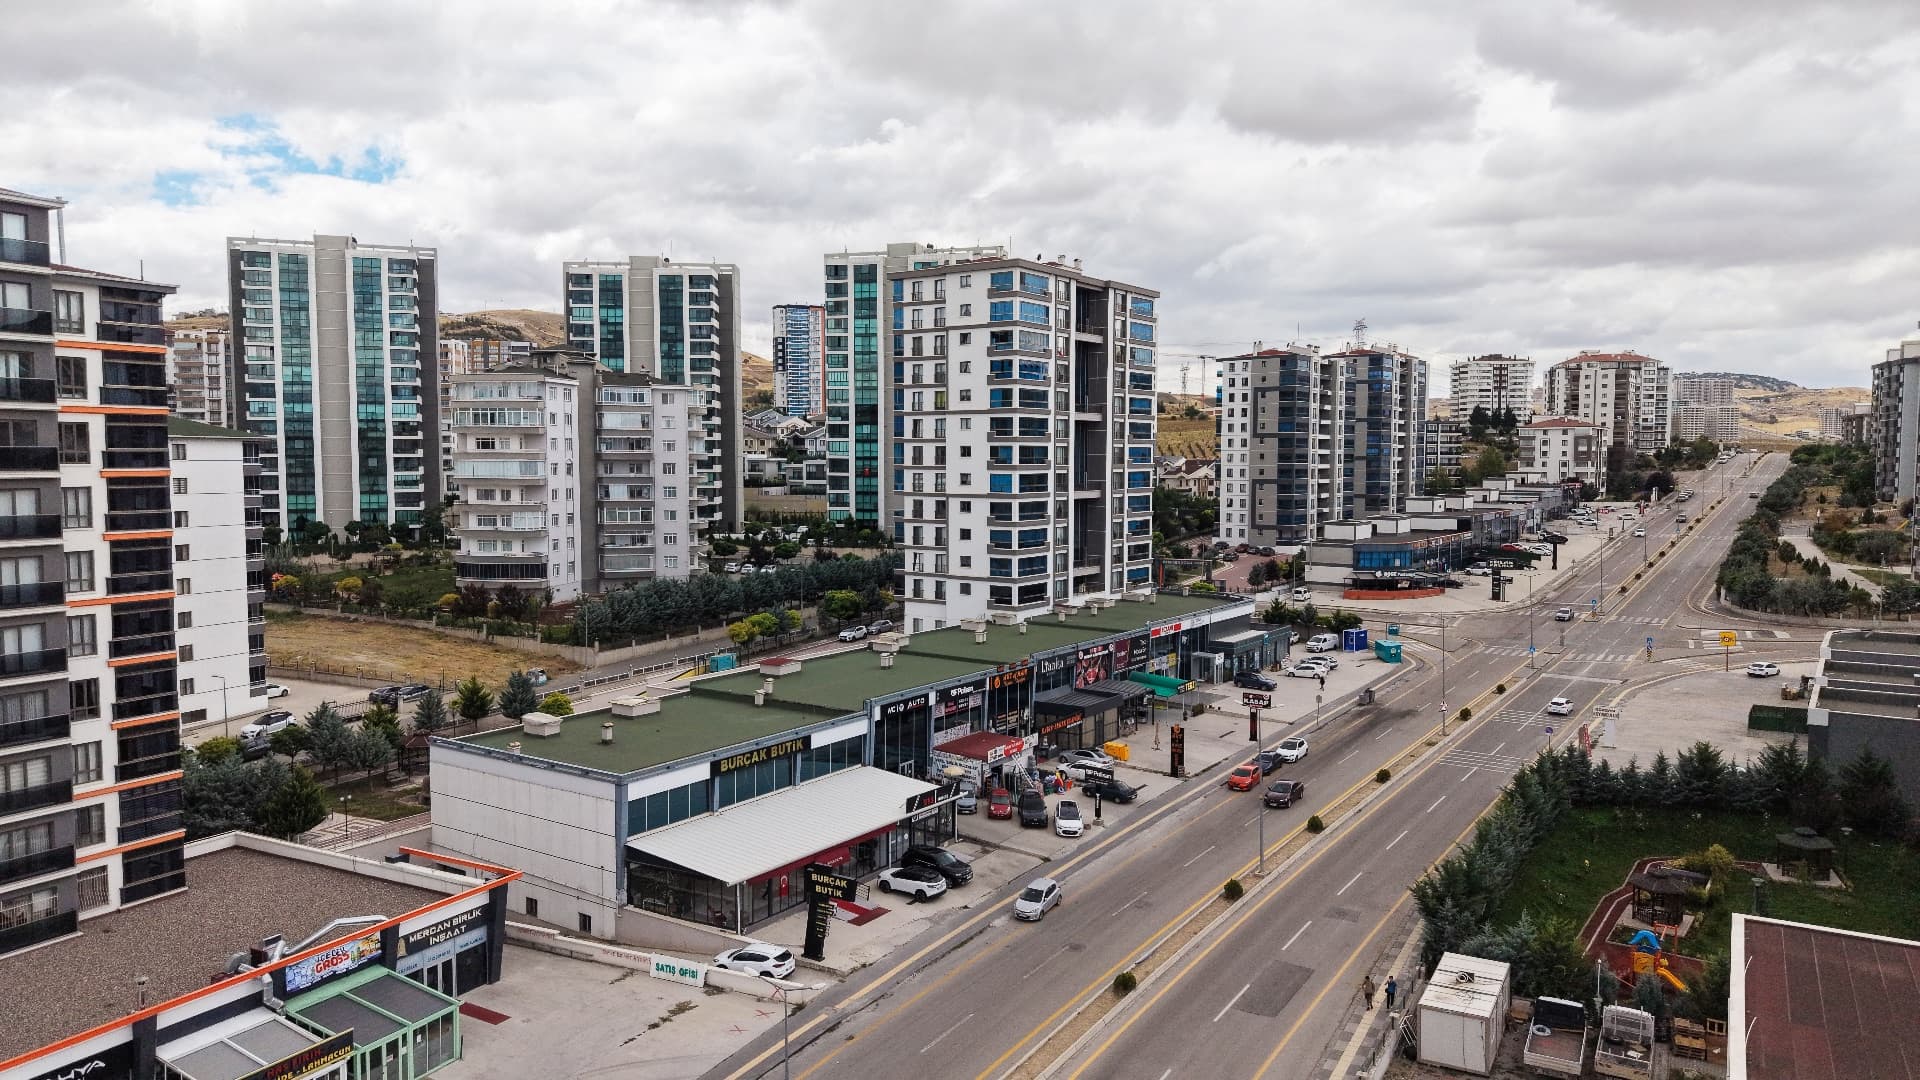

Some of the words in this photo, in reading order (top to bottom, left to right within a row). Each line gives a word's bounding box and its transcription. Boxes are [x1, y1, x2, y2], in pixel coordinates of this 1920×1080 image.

[907, 697, 925, 710] AUTO
[720, 748, 768, 773] BURÇAK
[770, 738, 804, 758] BUTİK
[811, 873, 848, 889] BURÇAK
[409, 920, 451, 944] MERCAN
[315, 952, 351, 974] GROSS
[655, 962, 676, 977] SATIŞ
[679, 968, 698, 980] OFİSİ
[302, 1045, 351, 1073] LAHMACUN
